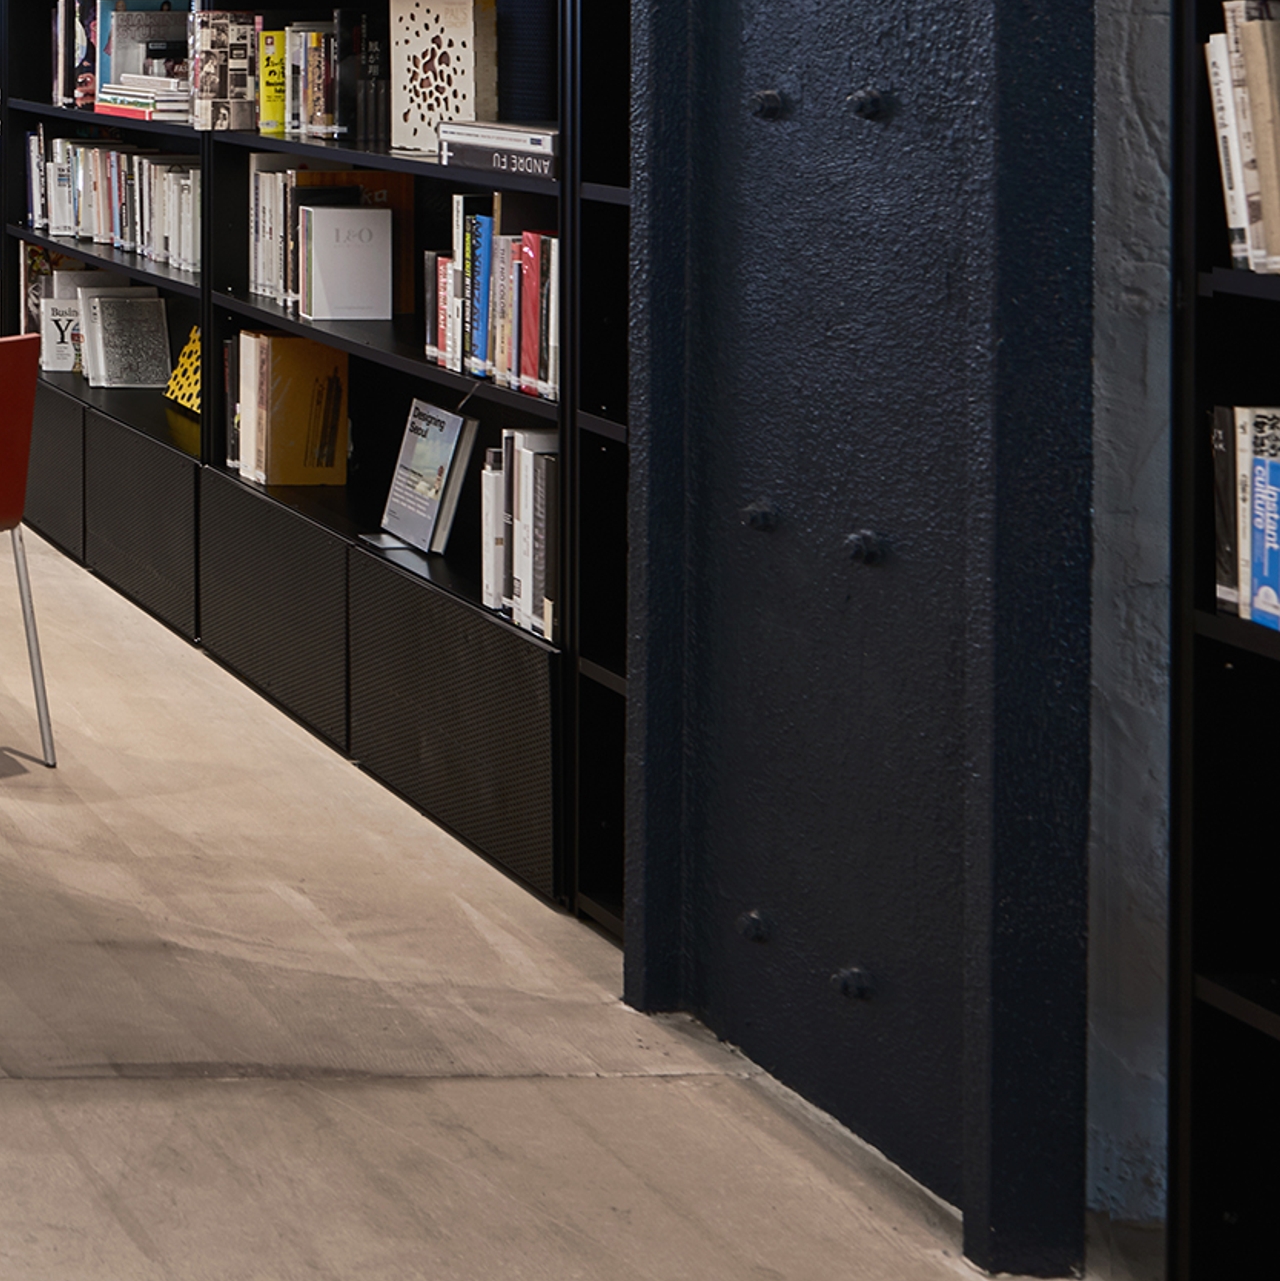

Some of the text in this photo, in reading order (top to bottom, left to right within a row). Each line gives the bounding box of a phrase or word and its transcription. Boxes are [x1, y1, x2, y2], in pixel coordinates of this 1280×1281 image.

[492, 152, 508, 169] FU
[51, 307, 79, 317] Busin
[409, 421, 428, 438] Seoul
[413, 406, 446, 432] Designing
[1254, 465, 1268, 530] culture
[1266, 485, 1279, 551] instant
